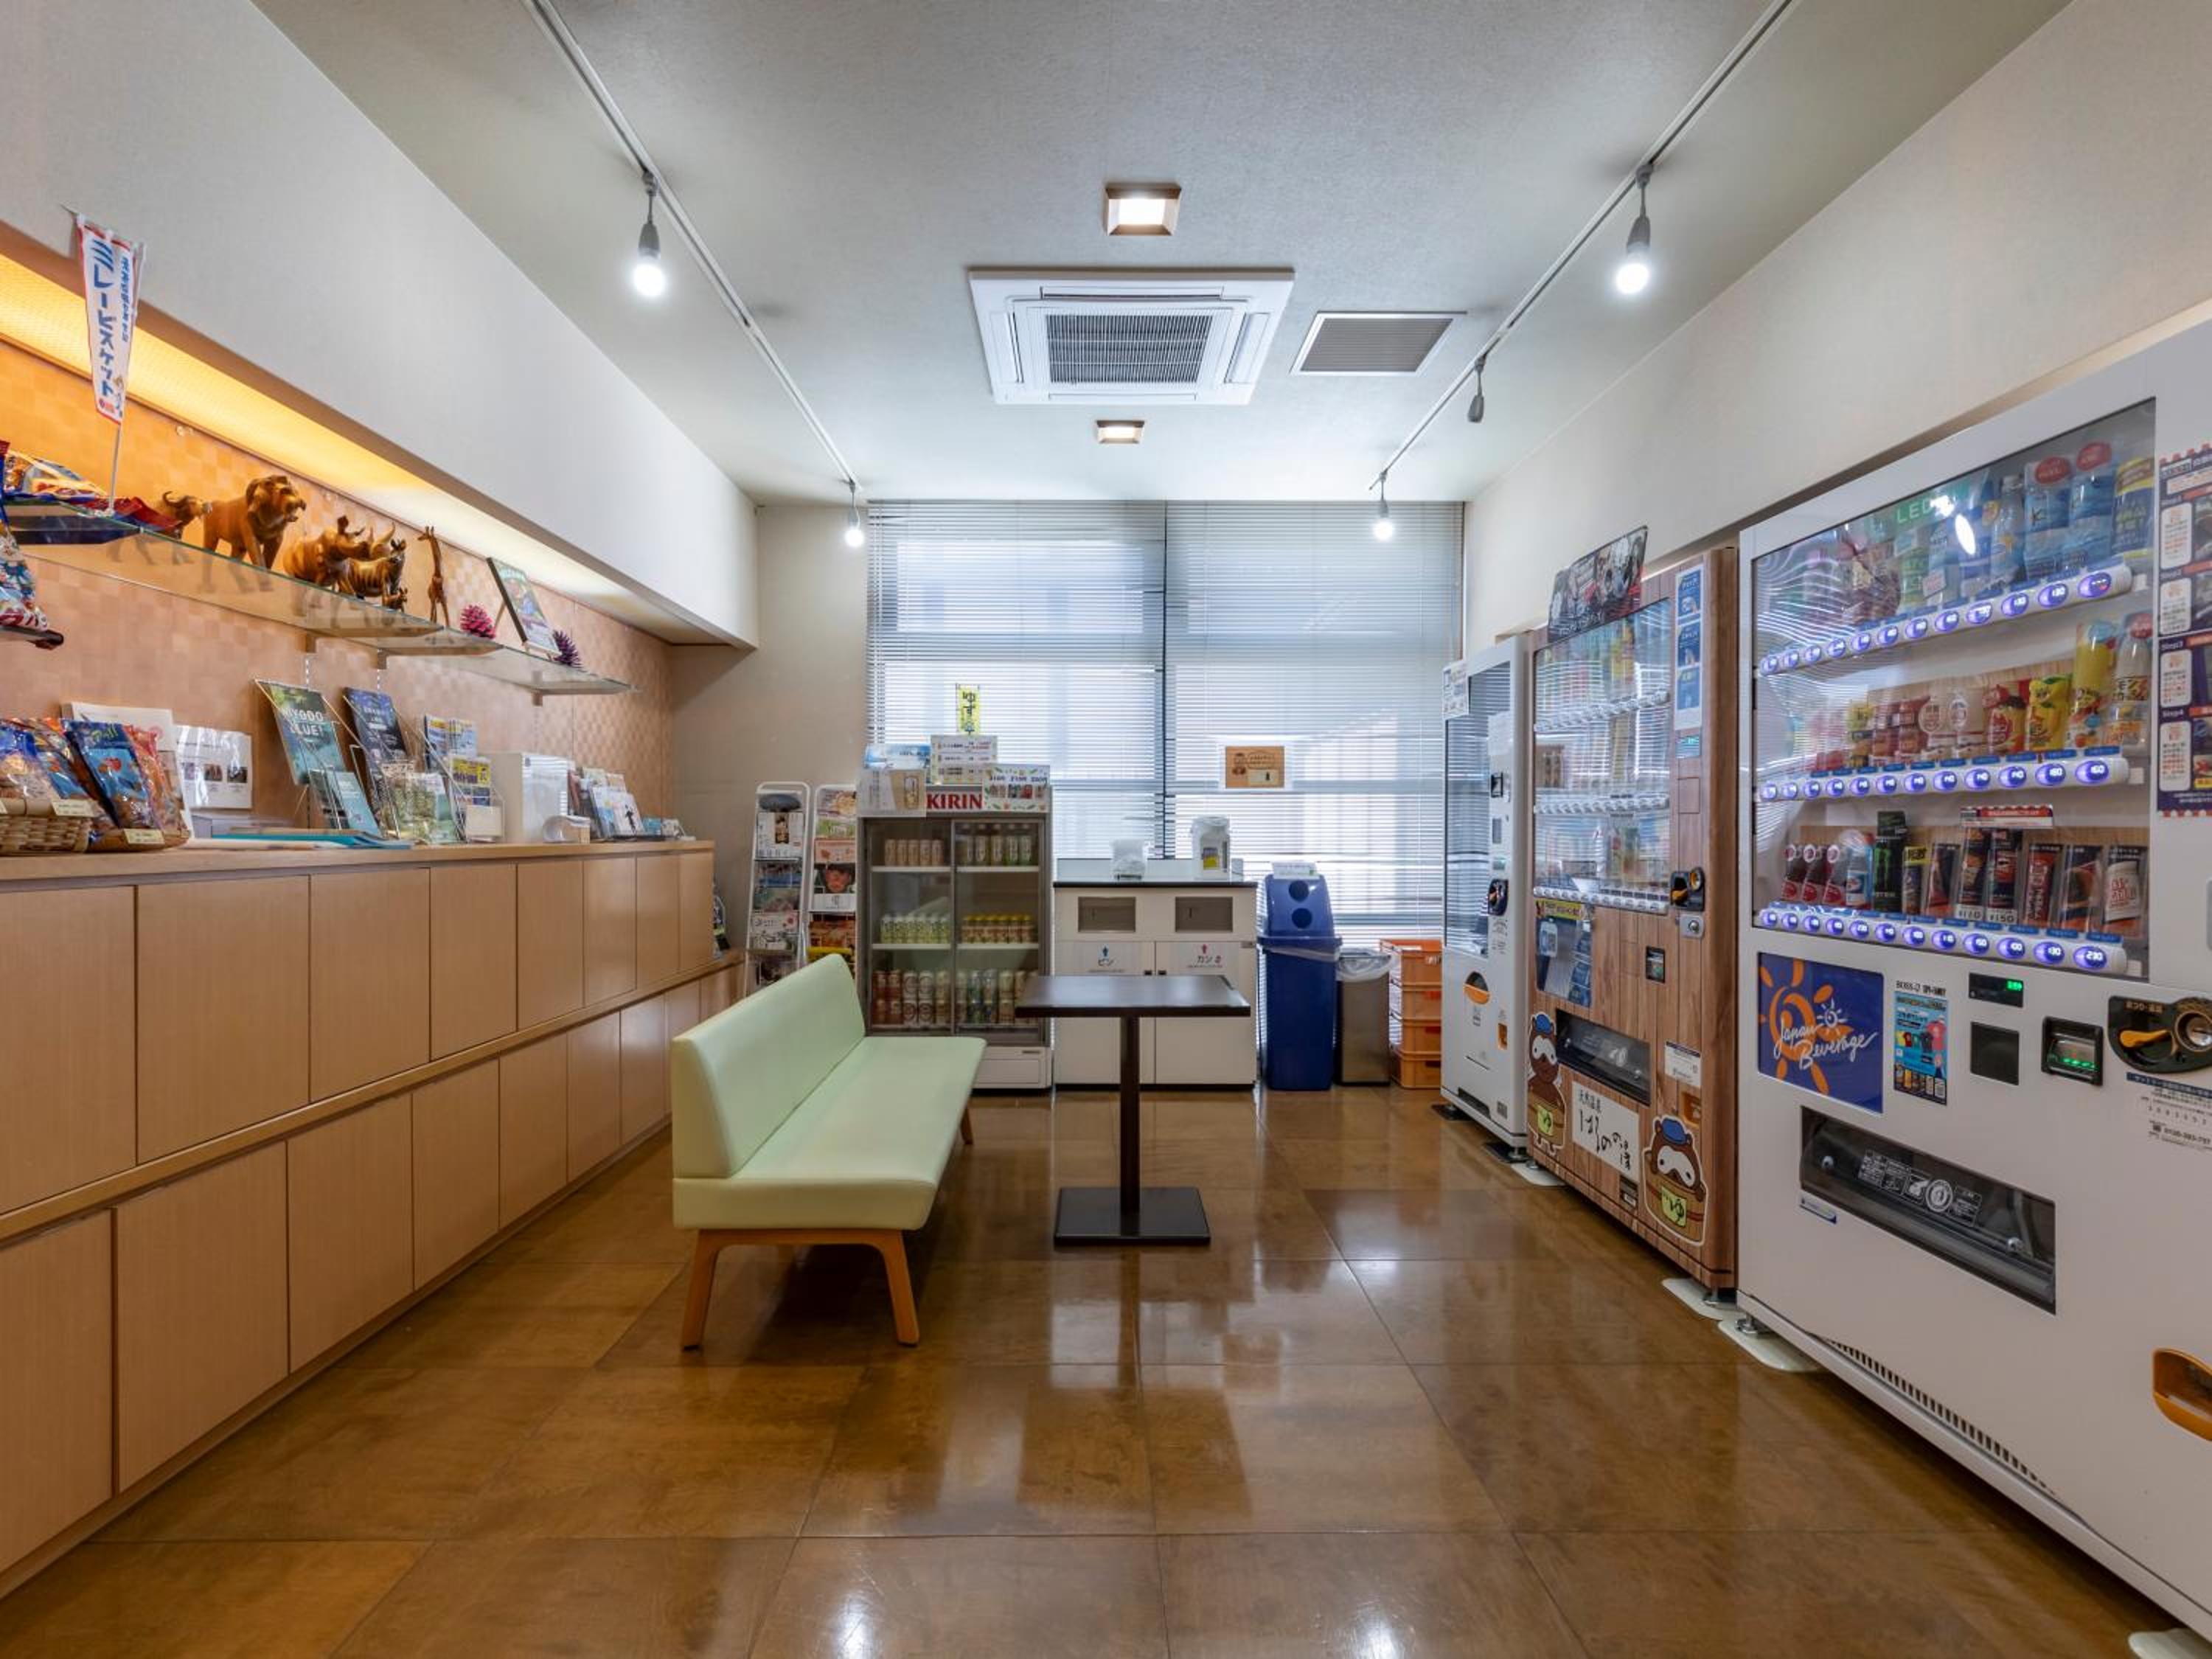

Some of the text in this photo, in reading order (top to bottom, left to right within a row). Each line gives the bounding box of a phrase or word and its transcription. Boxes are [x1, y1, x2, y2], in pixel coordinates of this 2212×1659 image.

[91, 237, 114, 397] ミレービスケット
[1897, 498, 1933, 524] LED
[926, 793, 982, 810] KIRIN
[1773, 1016, 1824, 1060] Japan
[1792, 1032, 1878, 1070] Beverage
